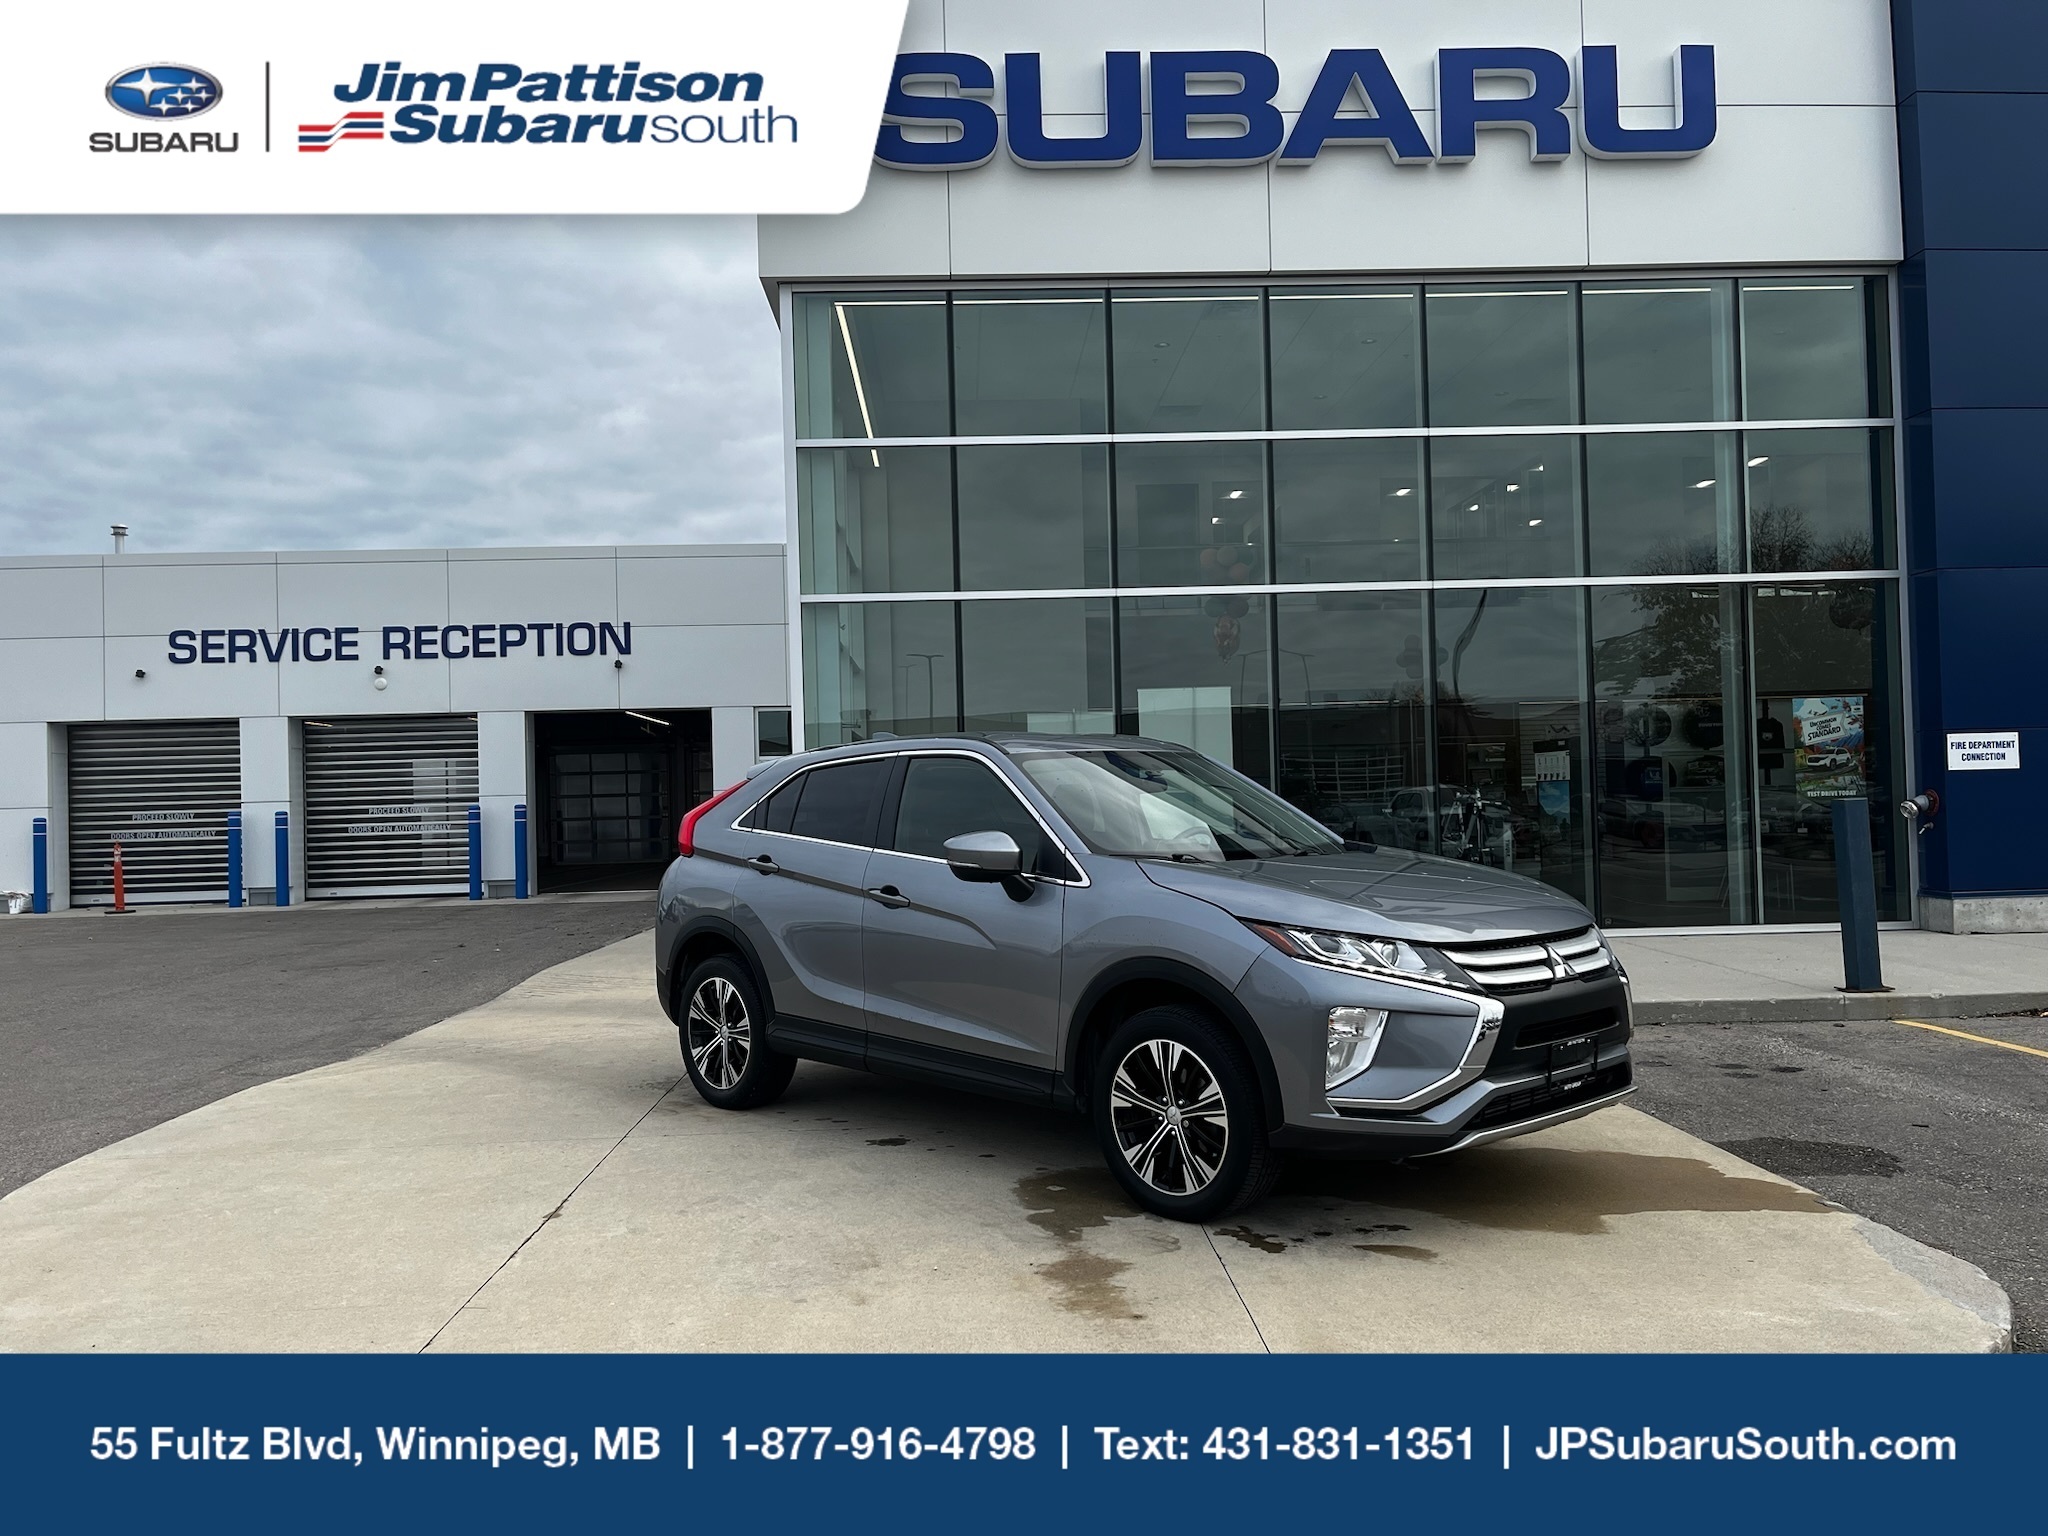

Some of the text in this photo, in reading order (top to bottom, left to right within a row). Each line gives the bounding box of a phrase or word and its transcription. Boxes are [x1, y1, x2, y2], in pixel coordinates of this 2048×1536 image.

[874, 44, 1718, 170] SUBARU
[168, 621, 632, 664] SERVICE RECEPTION
[1807, 726, 1841, 740] STANDARD
[1950, 740, 2016, 750] FIRE DEPARTMENT
[1961, 752, 2006, 762] CONNECTION
[368, 806, 430, 815] PROCEED SLOWLY
[132, 812, 195, 821] PROCEED SLOWLY
[394, 824, 451, 832] AUTOMATICALLY
[110, 832, 135, 840] DOORS
[157, 830, 217, 839] AUTOMATICALLY
